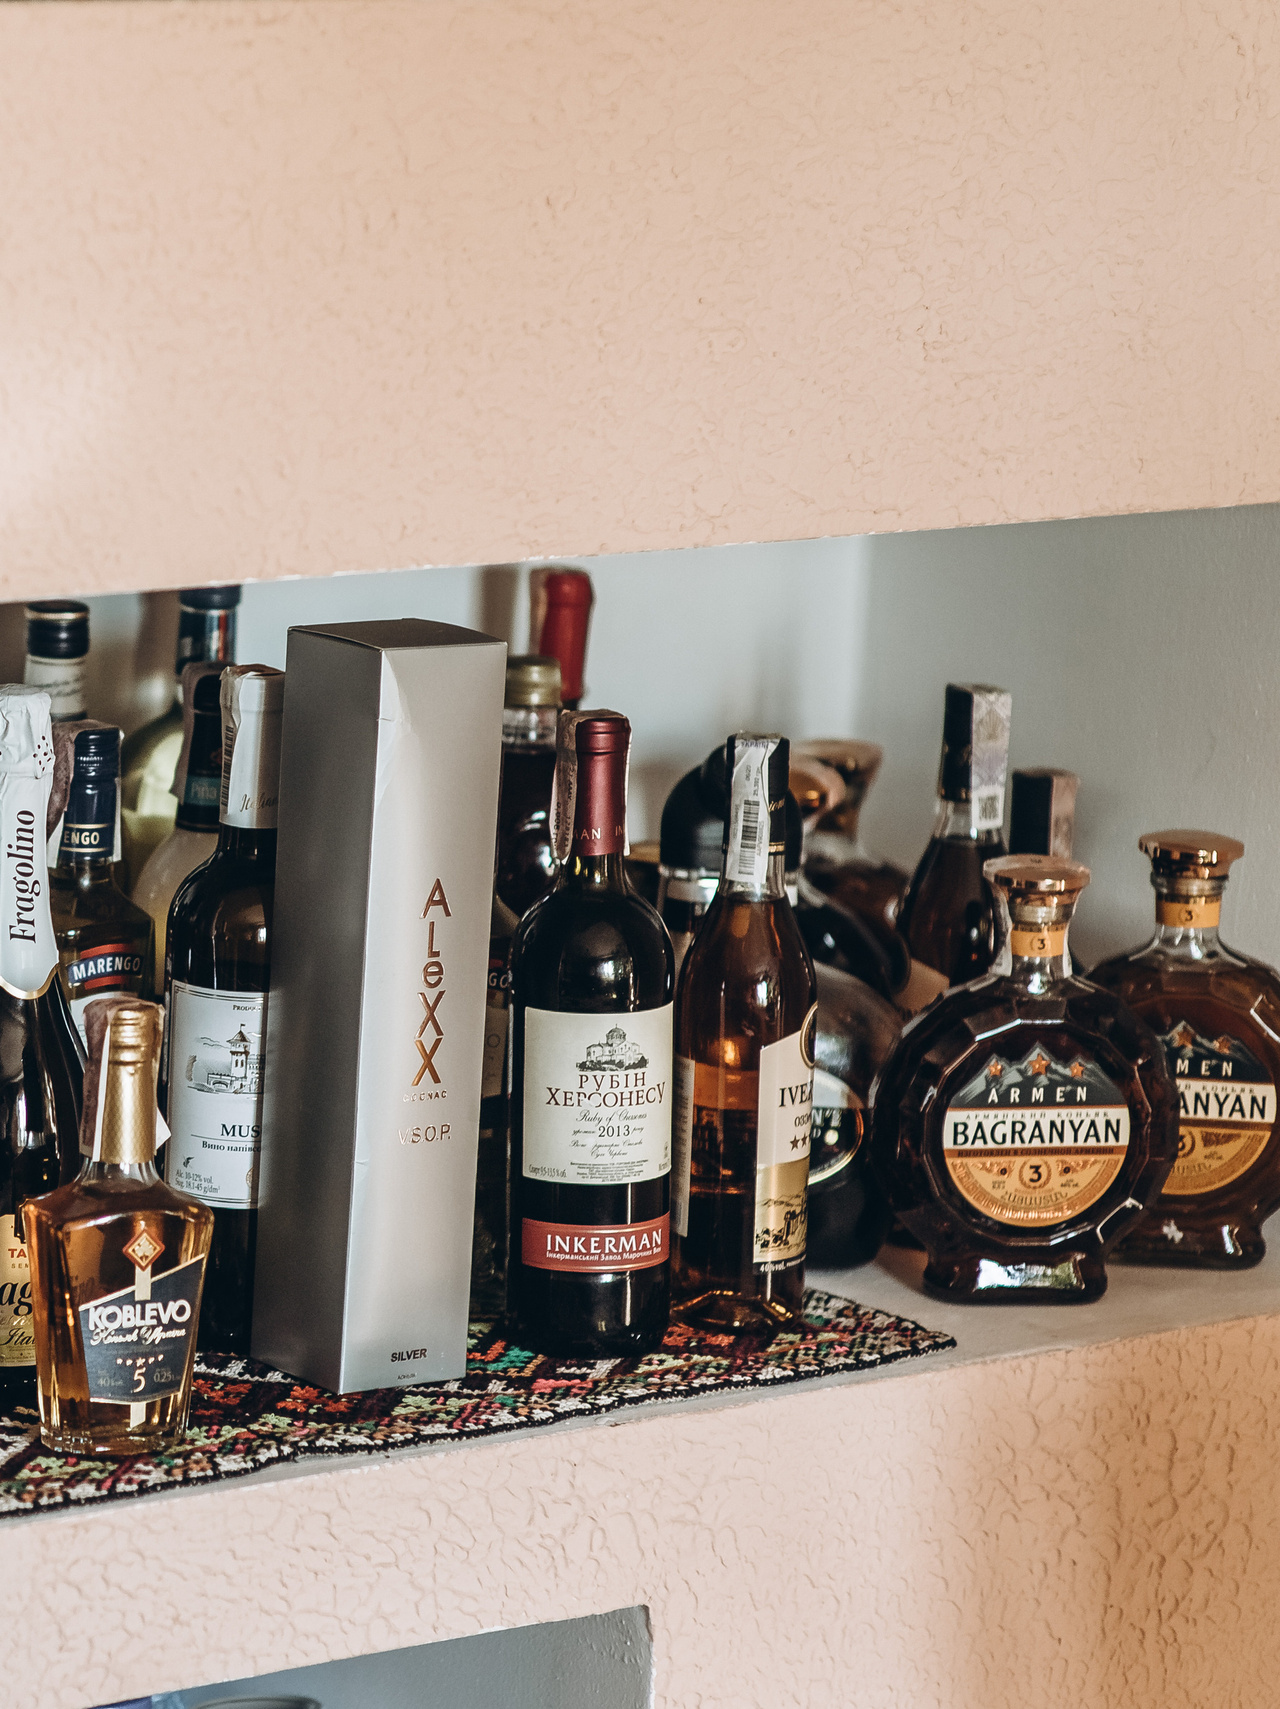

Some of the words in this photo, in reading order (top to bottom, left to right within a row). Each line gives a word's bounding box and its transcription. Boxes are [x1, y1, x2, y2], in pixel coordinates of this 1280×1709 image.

[574, 827, 602, 841] AN
[7, 810, 41, 944] Fragolino
[1036, 938, 1047, 951] 3
[73, 956, 141, 981] MARENGO
[578, 1072, 647, 1091] РУБІН
[402, 1090, 448, 1102] COGNAC
[546, 1081, 666, 1108] ХЕРСОНЕСУ
[987, 1086, 1088, 1104] ARMEN
[575, 1109, 604, 1127] Ruby
[605, 1111, 617, 1127] of
[220, 1122, 261, 1139] MUS
[598, 1124, 630, 1138] 2013
[952, 1118, 1121, 1146] BAGRANYAN
[201, 1140, 226, 1152] Вино
[1028, 1164, 1042, 1183] 3
[546, 1229, 663, 1255] INKERMAN
[88, 1299, 192, 1331] KOBLEVO
[390, 1348, 428, 1363] SILVER
[130, 1366, 147, 1394] 5
